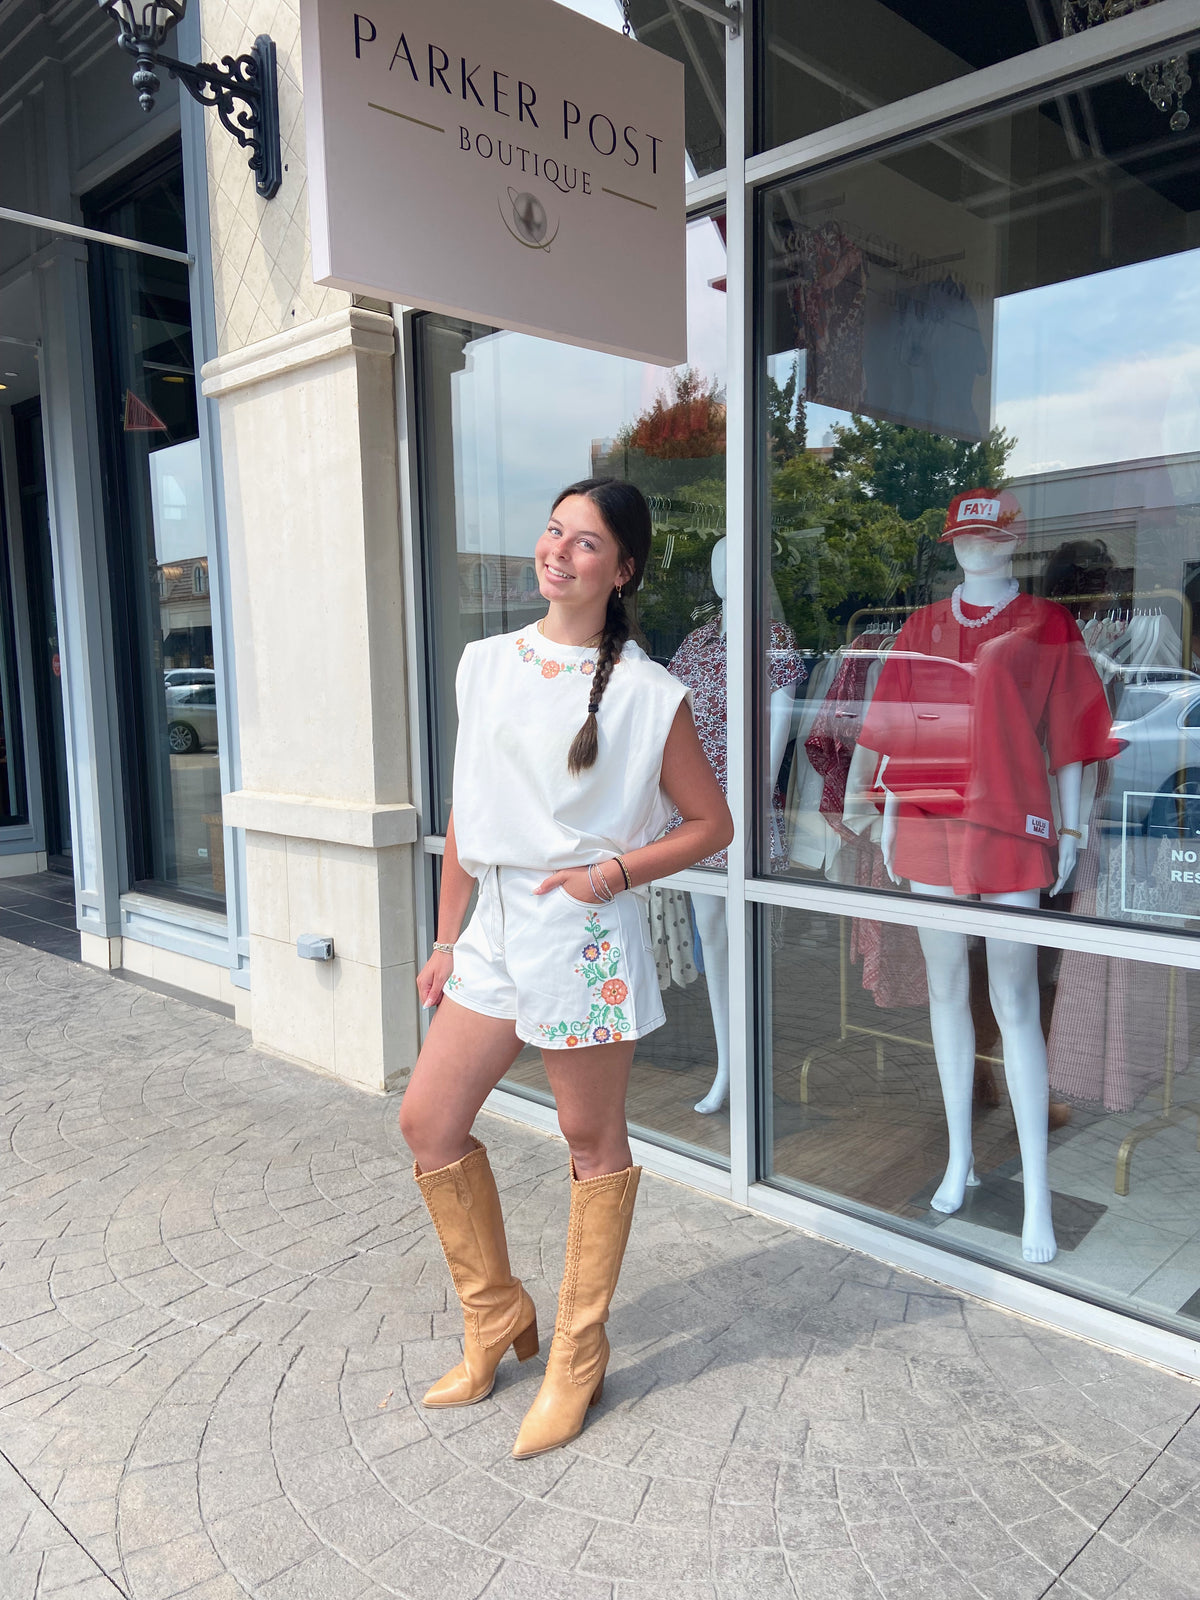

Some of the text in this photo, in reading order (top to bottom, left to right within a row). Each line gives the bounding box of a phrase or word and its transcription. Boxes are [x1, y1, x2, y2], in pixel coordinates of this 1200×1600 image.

[353, 13, 663, 174] PARKER POST
[459, 126, 592, 195] BOUTIQUE
[963, 503, 993, 516] FAY!
[1171, 849, 1197, 863] NO
